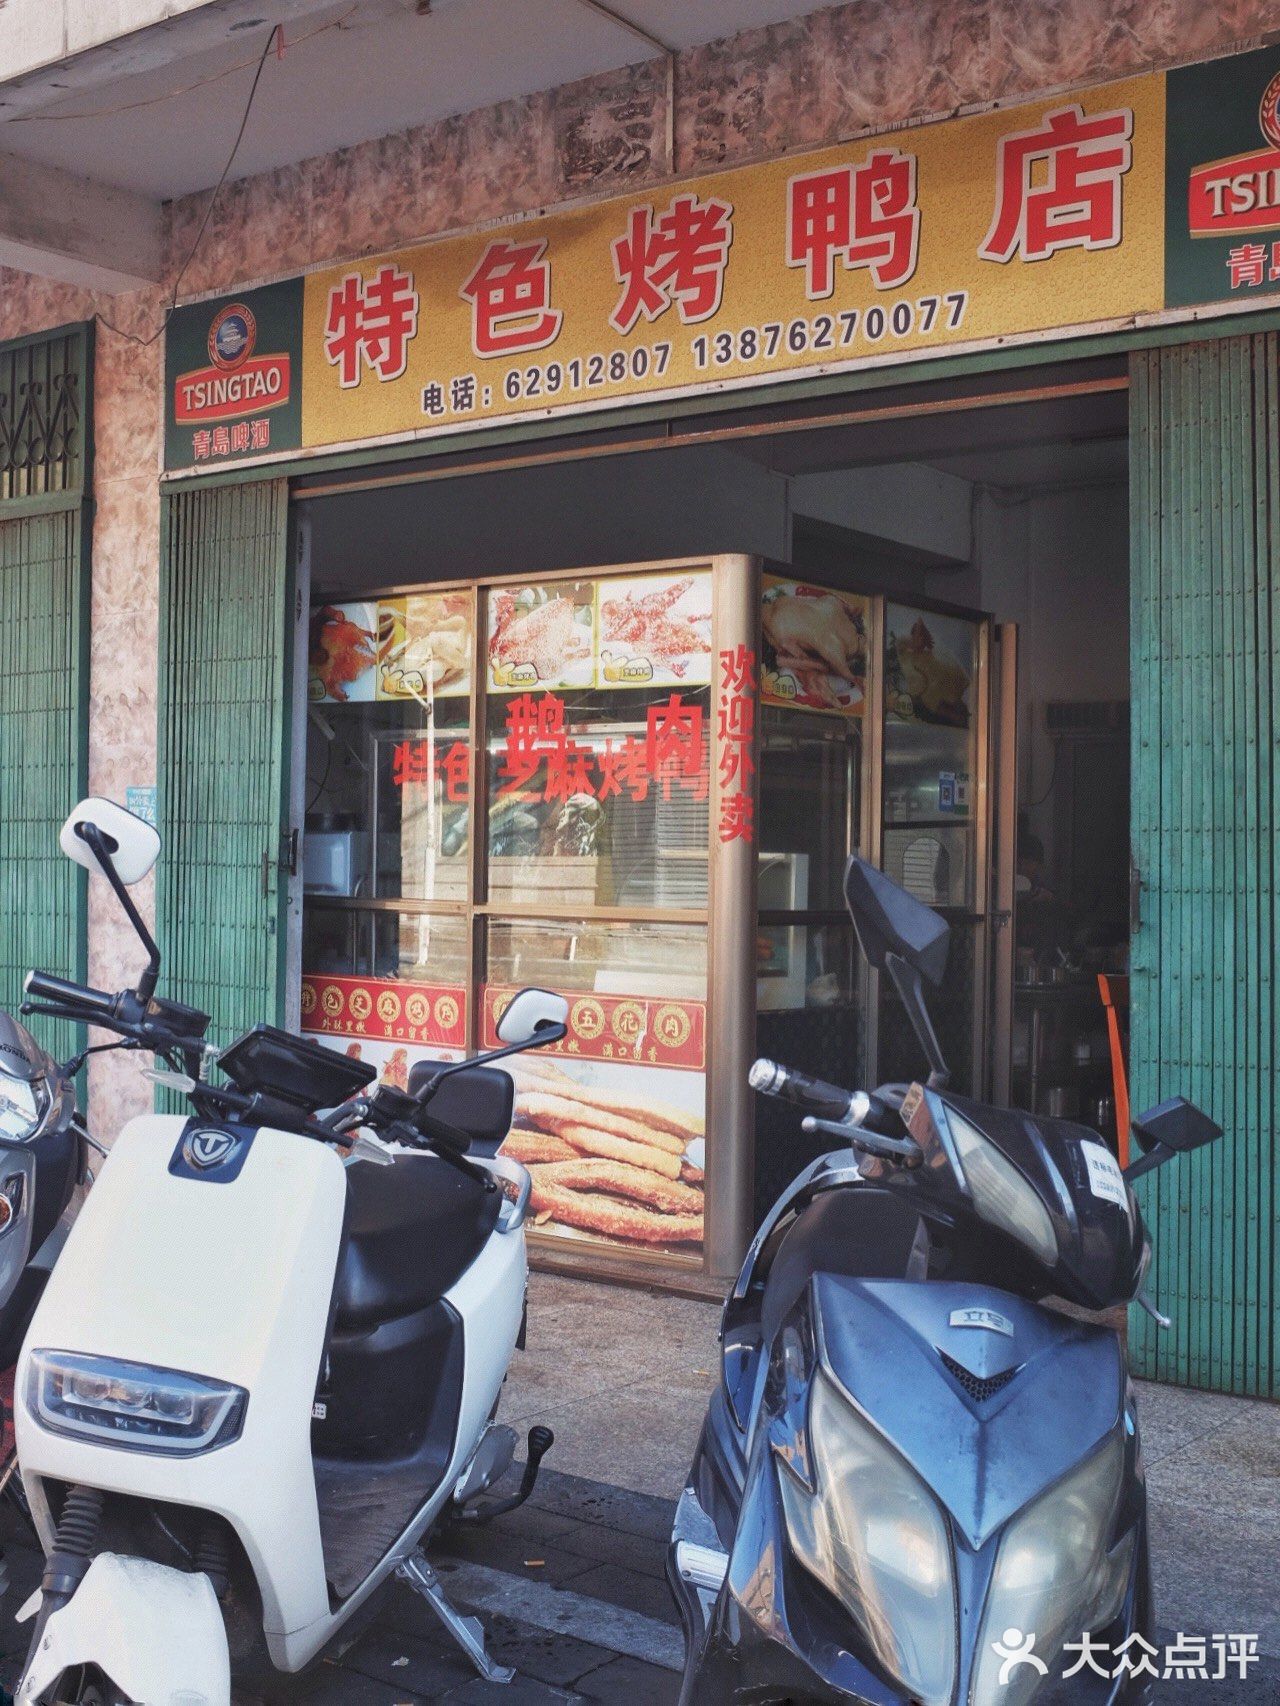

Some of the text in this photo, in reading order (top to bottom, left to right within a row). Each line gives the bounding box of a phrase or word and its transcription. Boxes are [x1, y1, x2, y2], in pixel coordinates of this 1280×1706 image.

[324, 104, 1133, 389] 特色烤鸭店
[692, 291, 970, 370] 13876270077
[182, 367, 282, 411] TSINGTAO
[192, 419, 270, 460] 青島啤酒
[718, 644, 755, 843] 欢迎外卖
